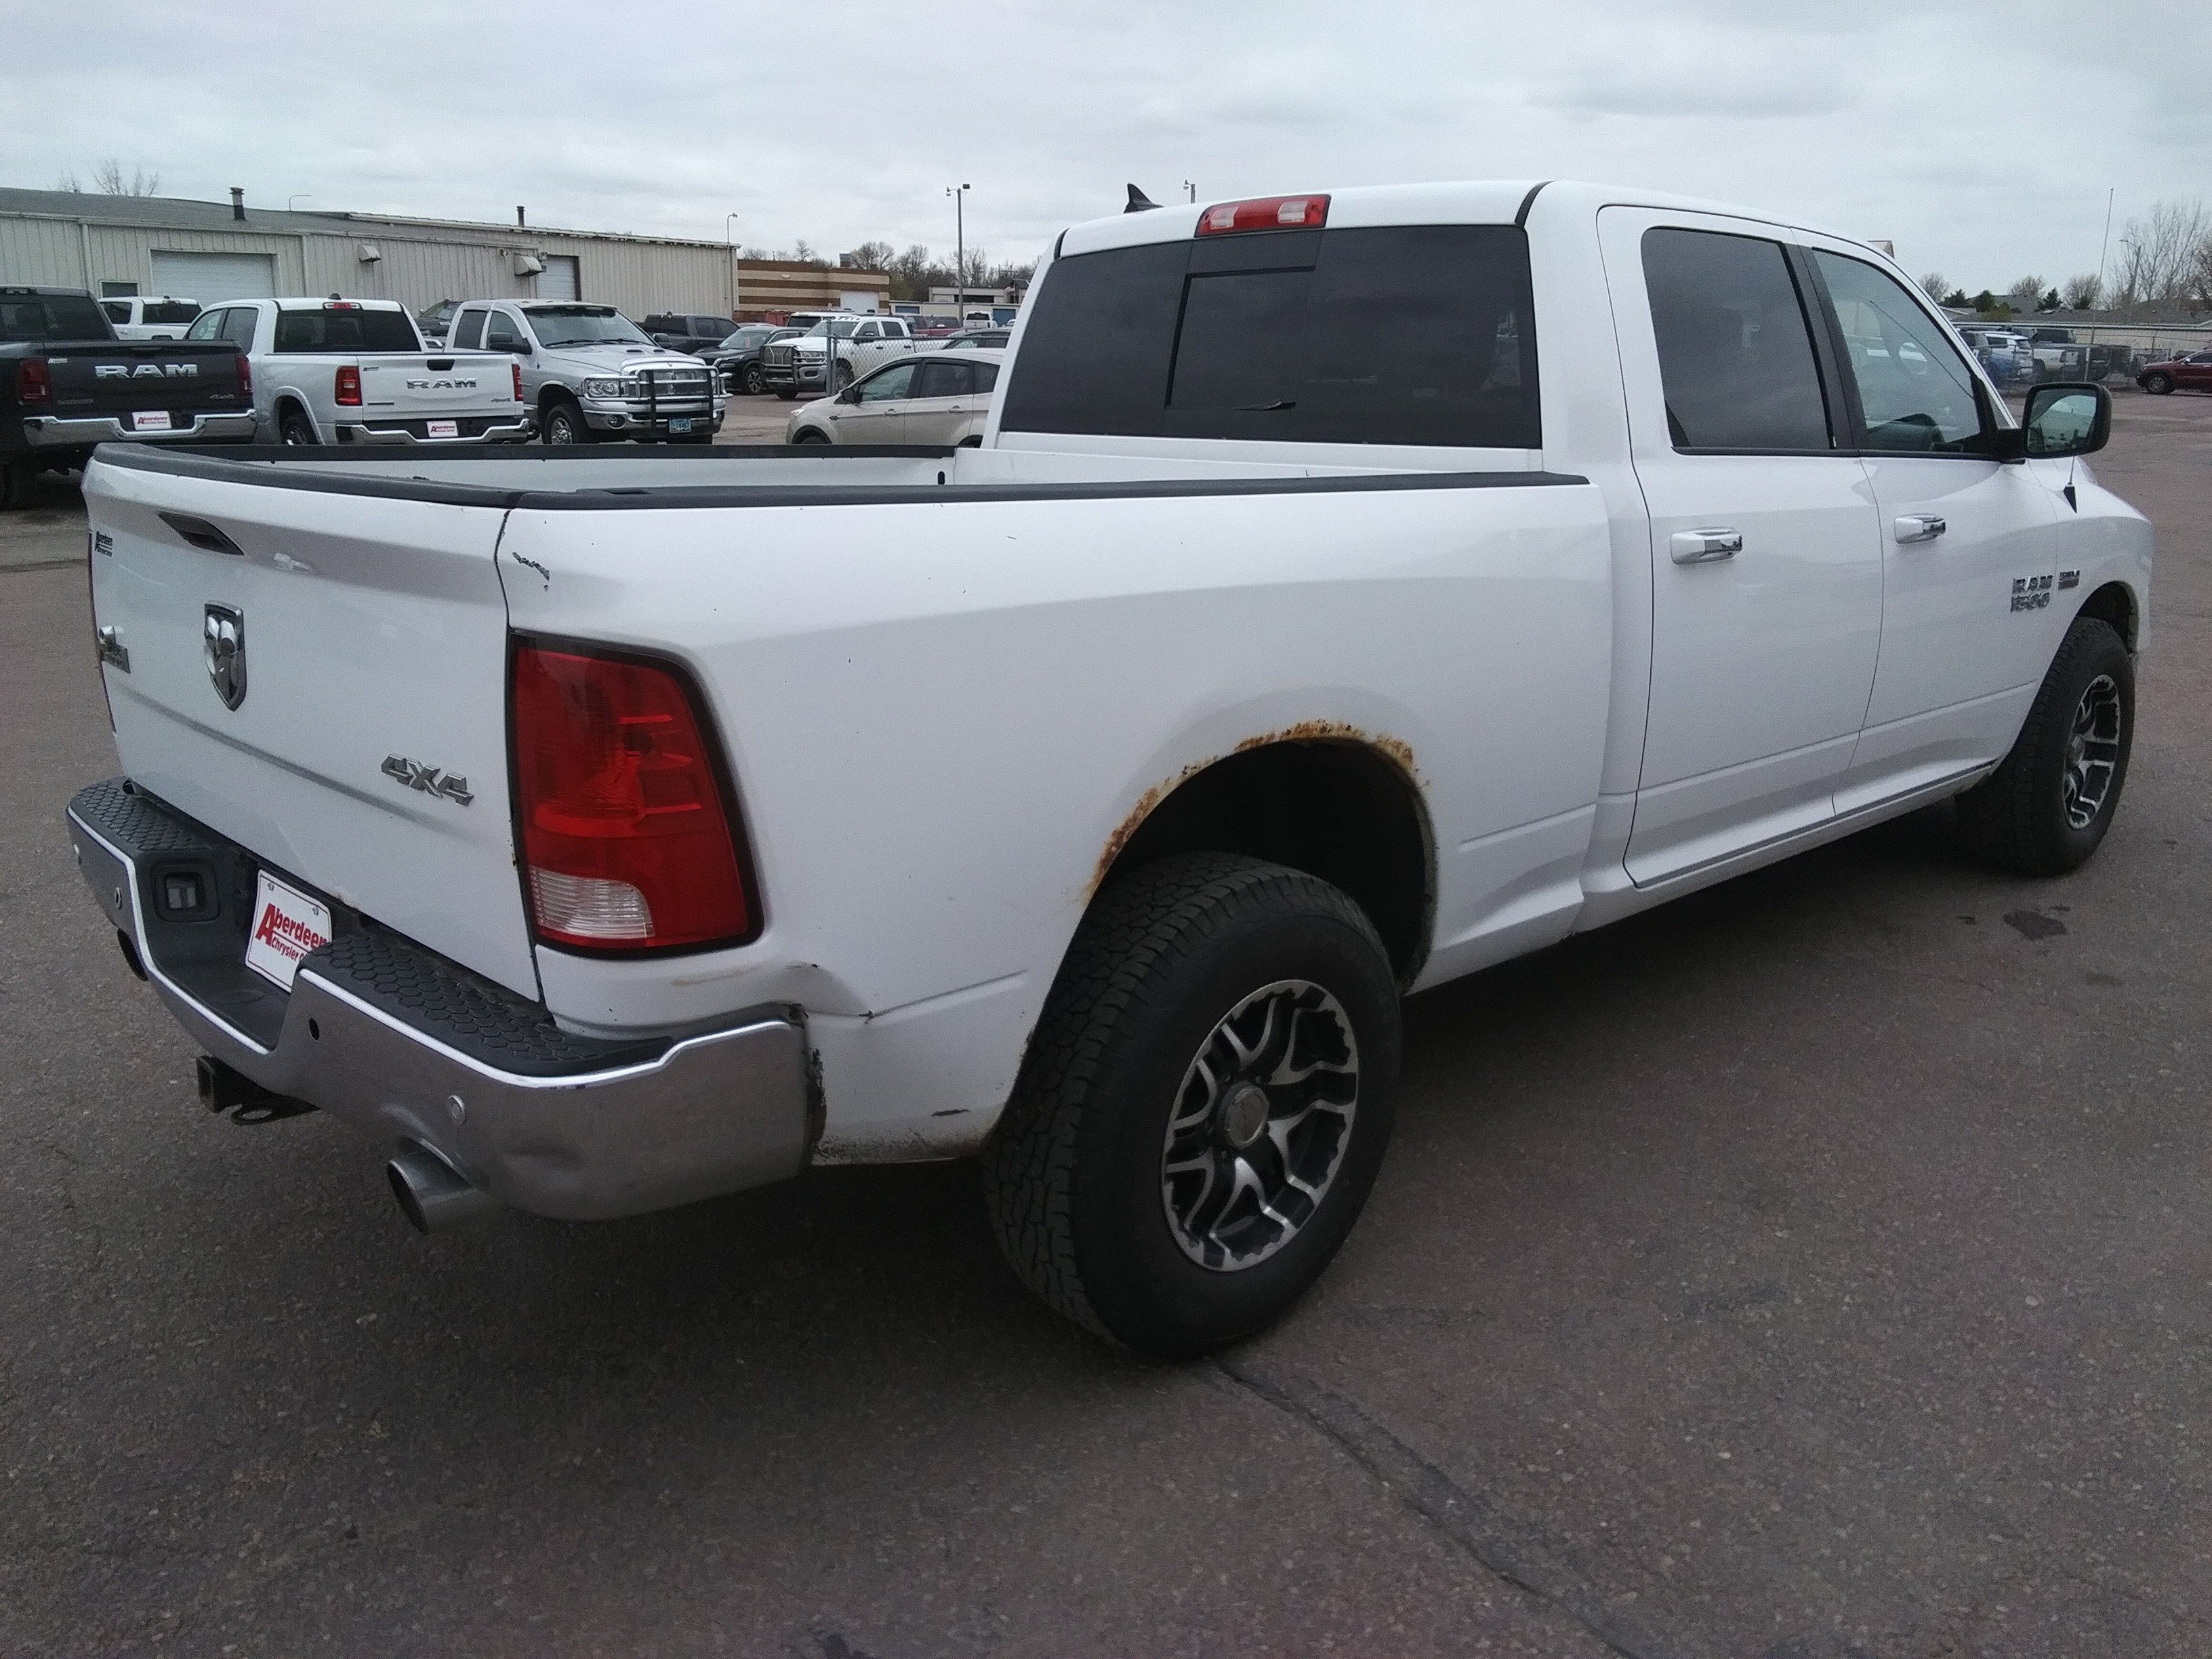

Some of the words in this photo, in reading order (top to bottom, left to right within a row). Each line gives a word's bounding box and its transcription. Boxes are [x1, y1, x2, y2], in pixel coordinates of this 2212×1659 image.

[94, 363, 199, 379] RAM
[406, 377, 477, 389] RAM
[2012, 575, 2053, 594] RAM
[2010, 592, 2051, 612] 1500
[270, 937, 299, 962] Chrysler
